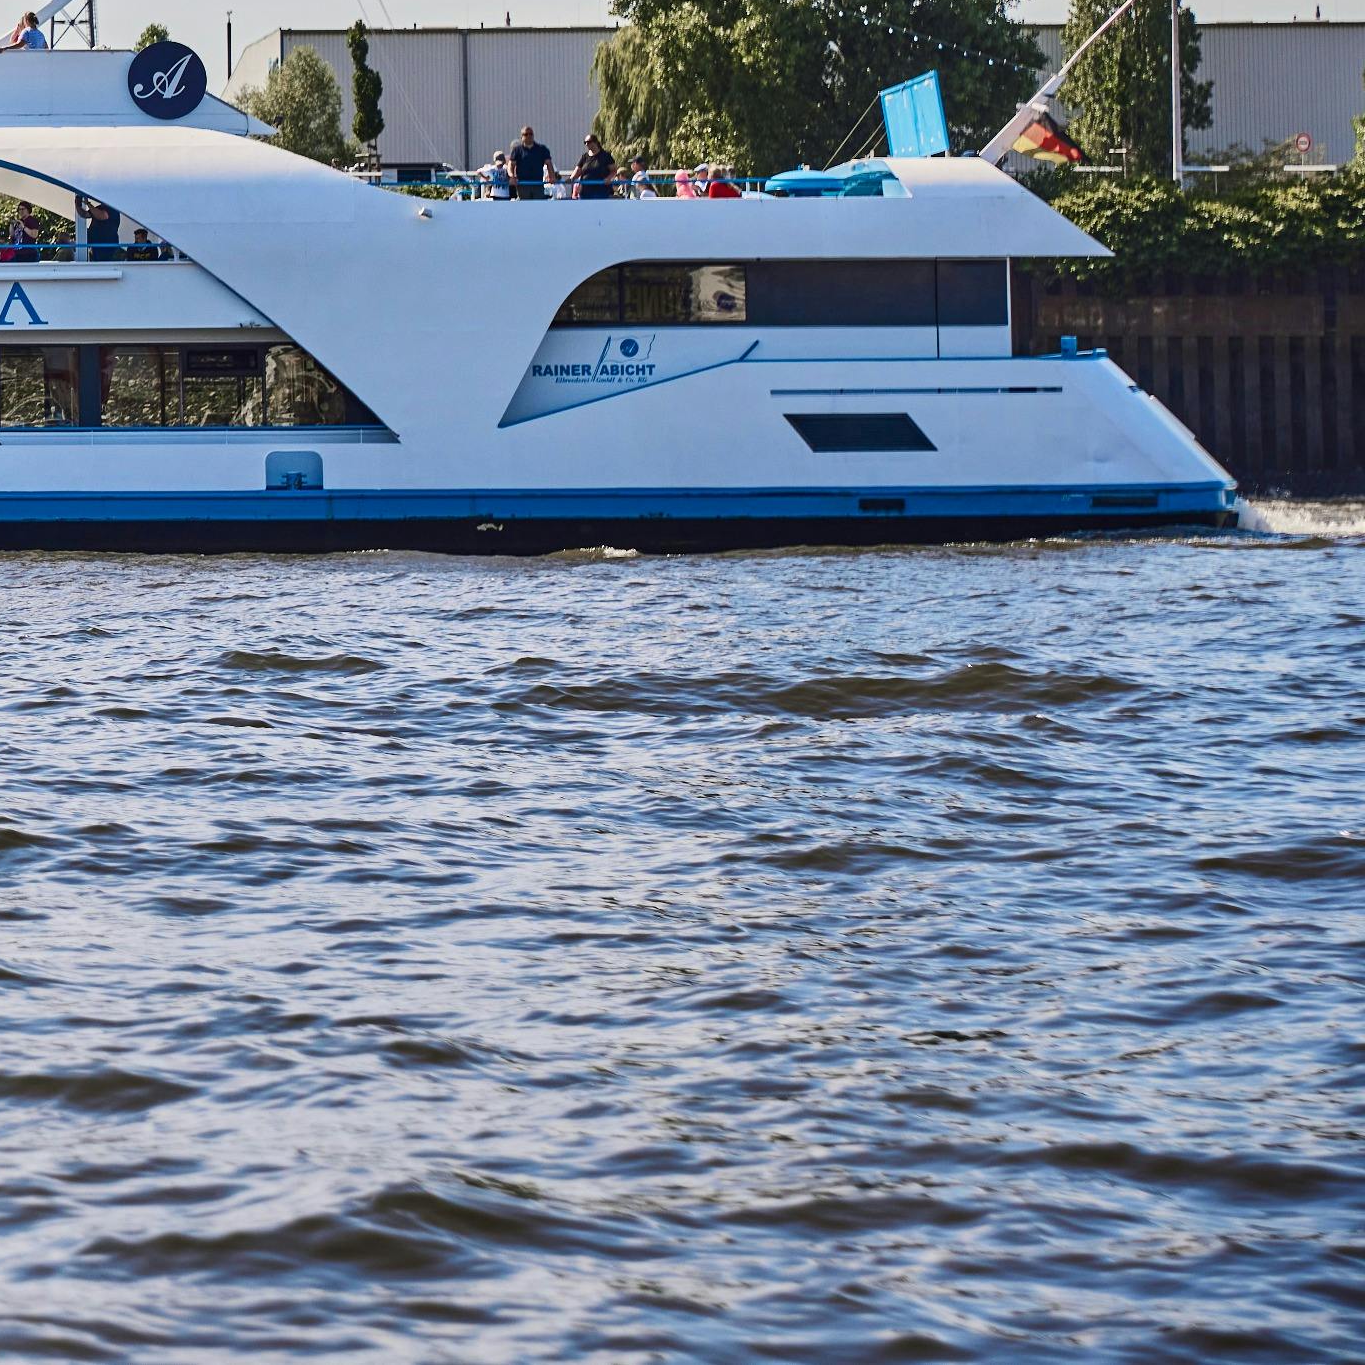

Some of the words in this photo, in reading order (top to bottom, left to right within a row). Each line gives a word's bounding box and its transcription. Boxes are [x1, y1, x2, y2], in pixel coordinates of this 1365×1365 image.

[133, 53, 193, 99] A
[532, 364, 592, 376] RAINER
[599, 364, 655, 376] ABICHT
